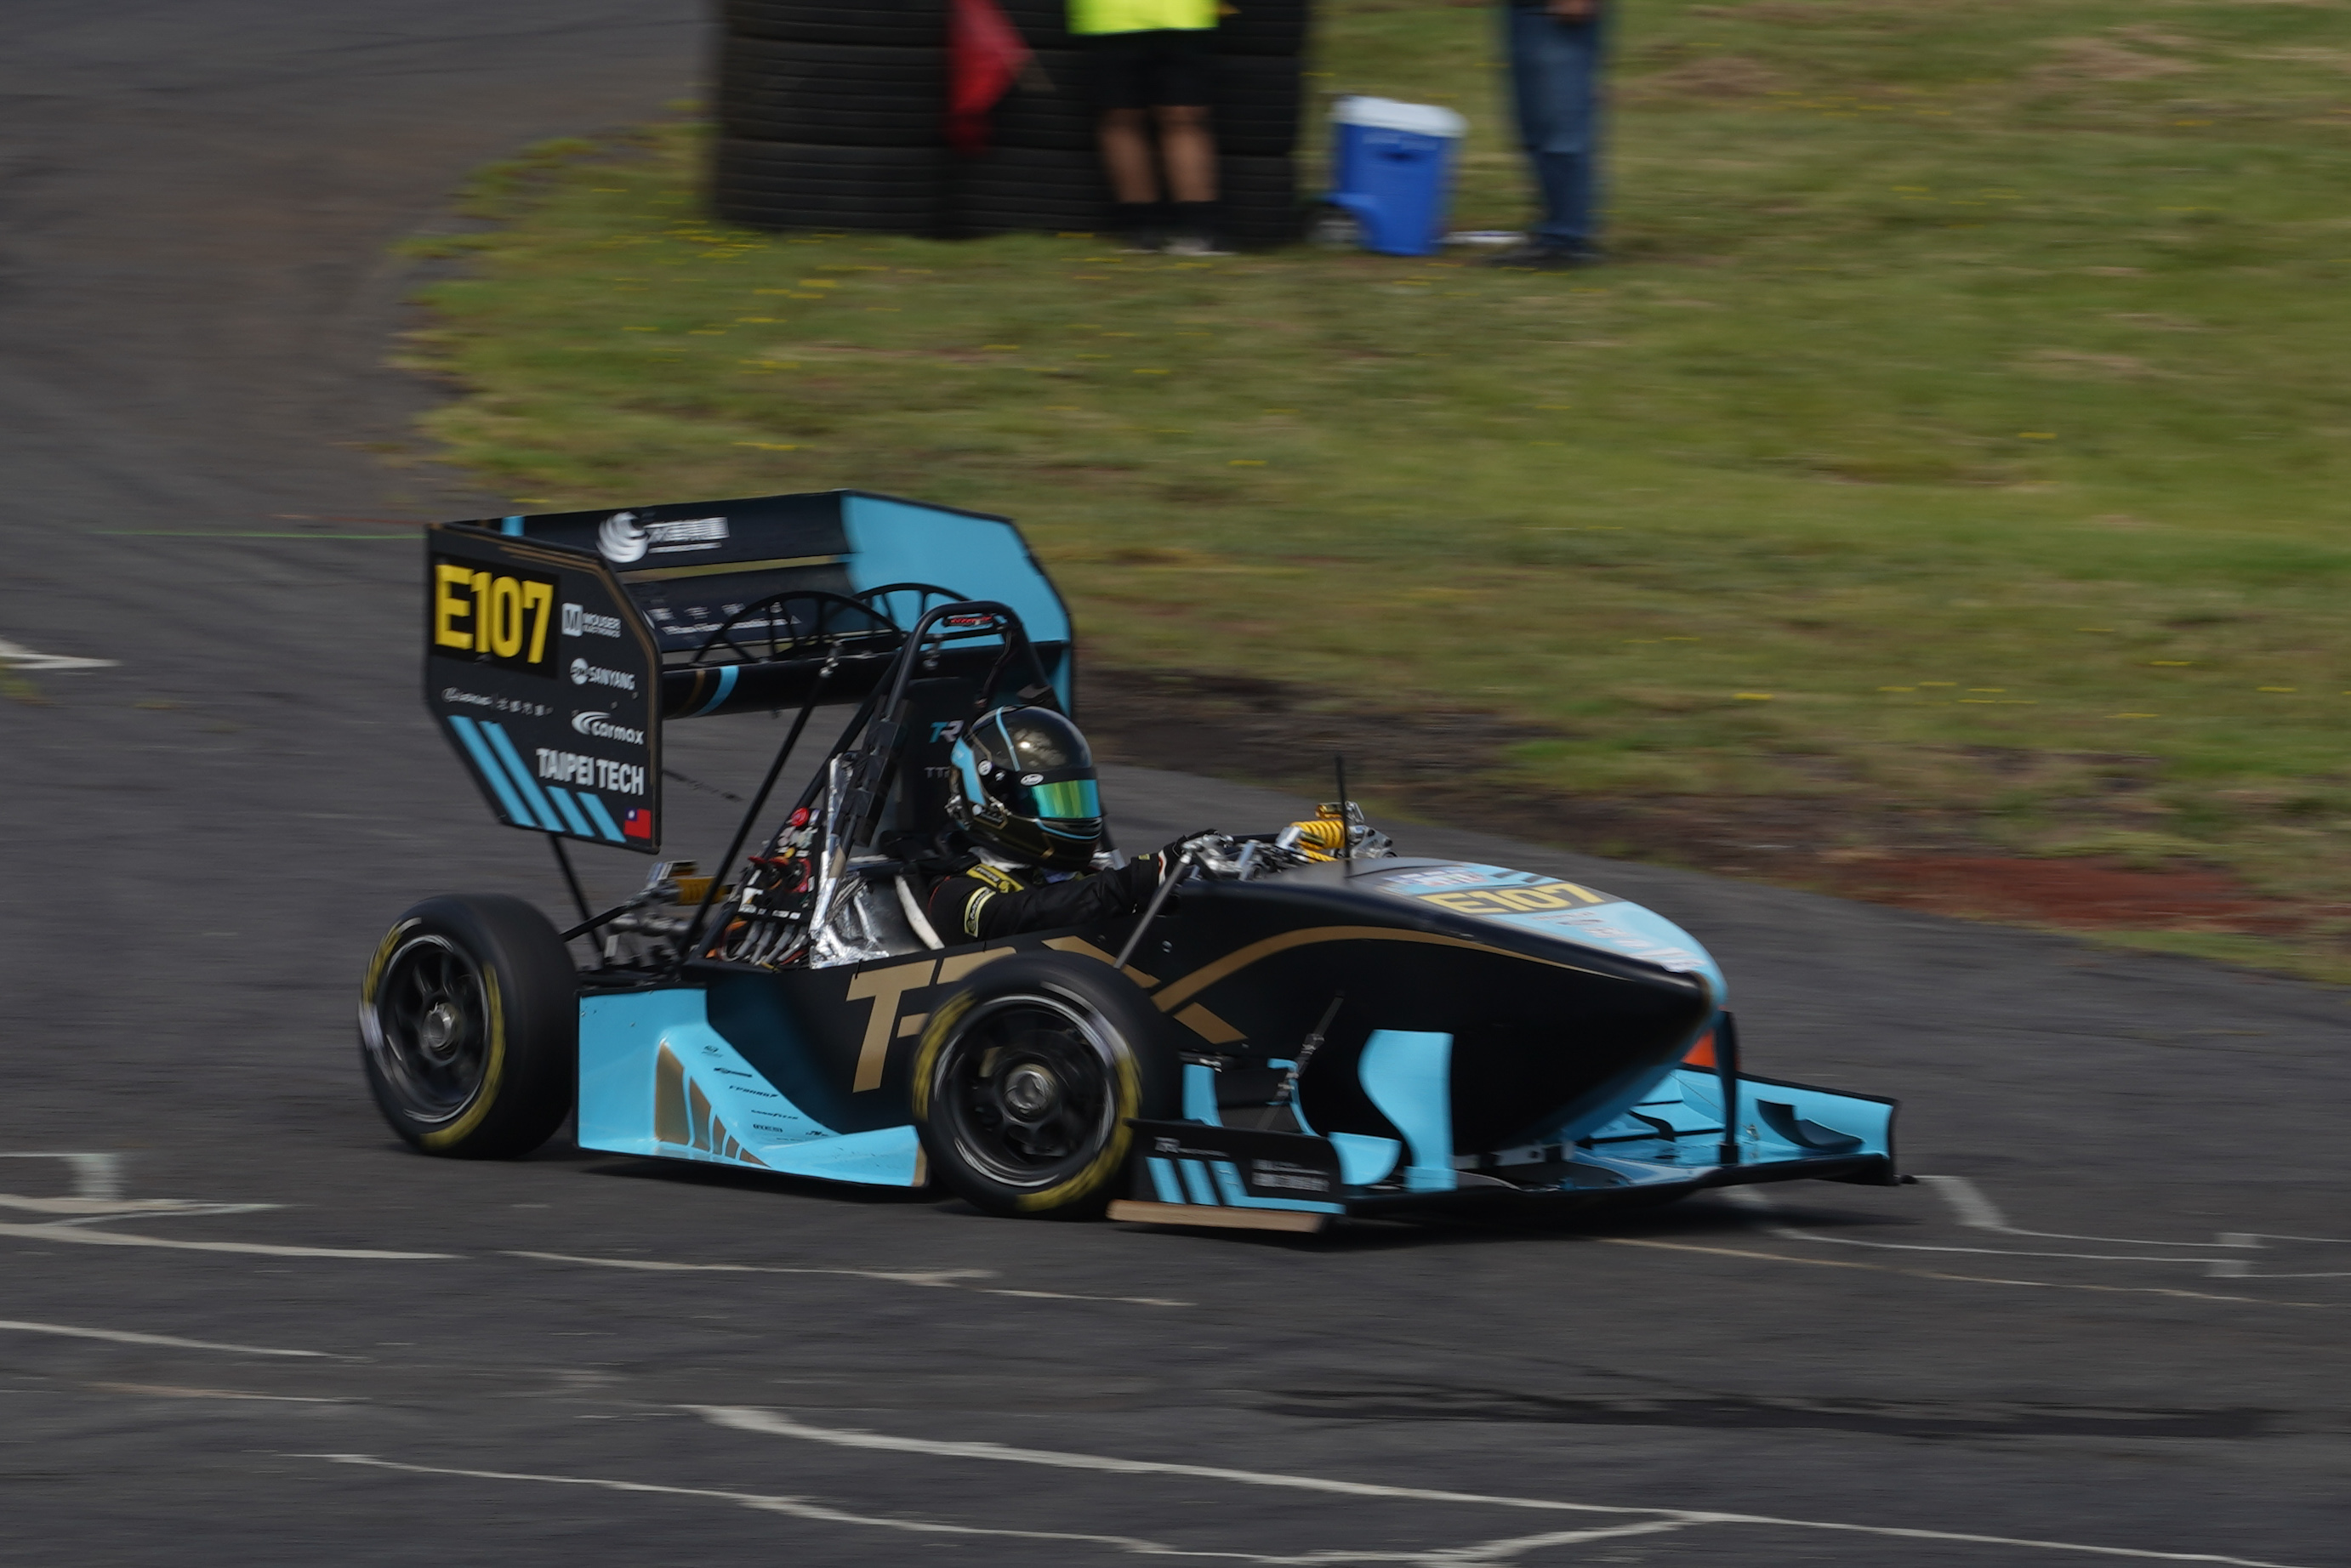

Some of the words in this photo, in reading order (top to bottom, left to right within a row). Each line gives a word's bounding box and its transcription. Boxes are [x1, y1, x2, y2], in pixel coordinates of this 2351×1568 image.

[435, 565, 554, 664] E107
[588, 666, 635, 690] SANYANG
[536, 747, 595, 786] TAIPEI
[596, 758, 645, 796] TECH
[1417, 883, 1606, 914] E107
